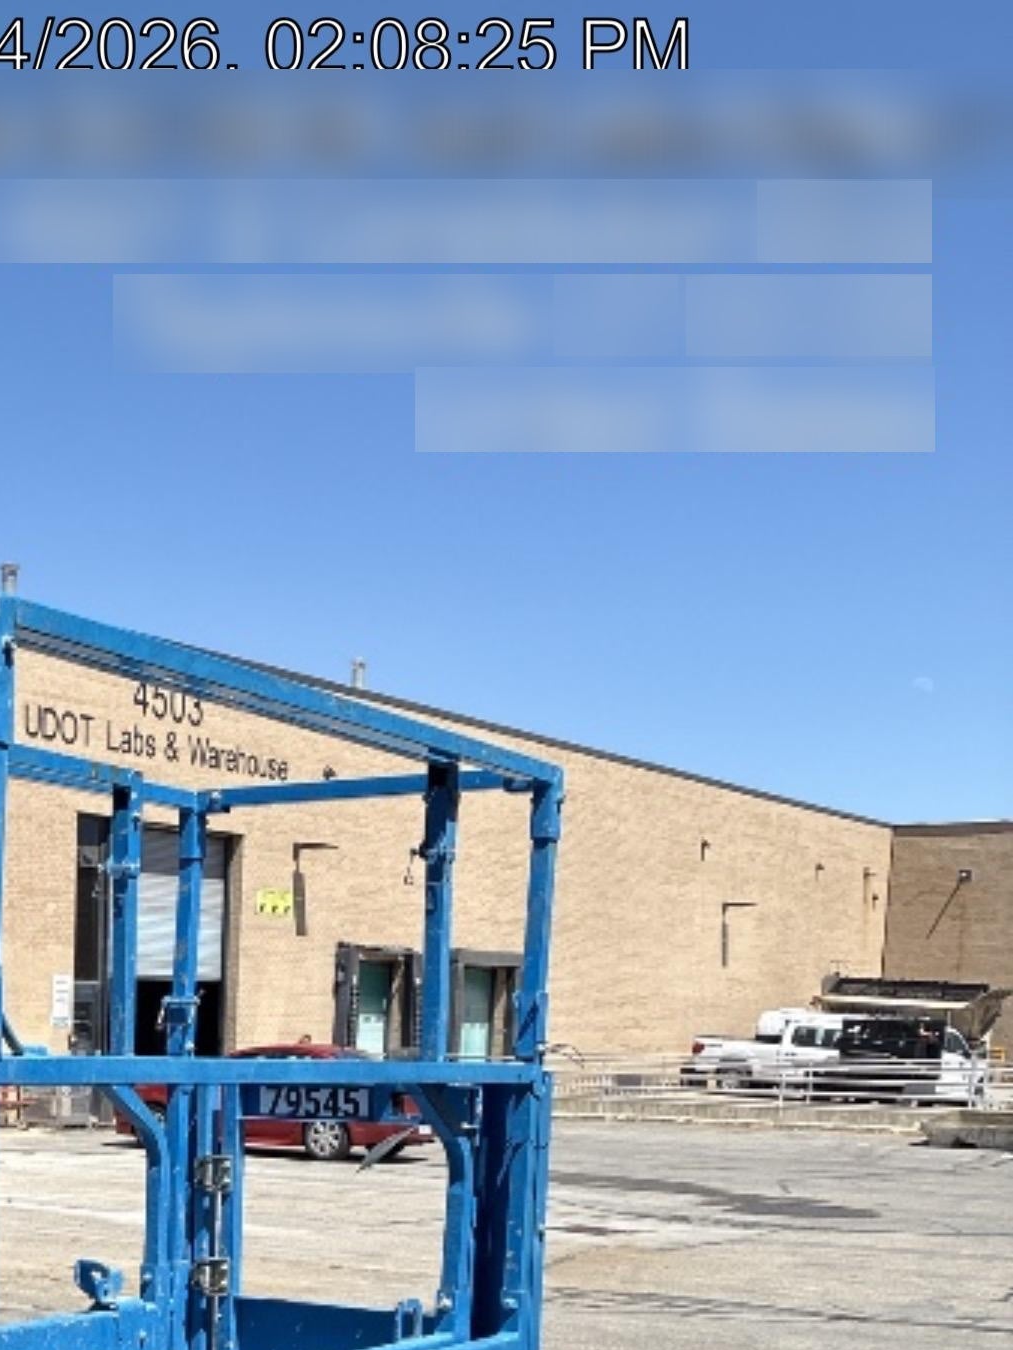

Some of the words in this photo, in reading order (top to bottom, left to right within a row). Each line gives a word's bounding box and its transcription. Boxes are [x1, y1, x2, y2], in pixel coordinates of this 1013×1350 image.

[133, 682, 204, 727] 4503
[25, 703, 95, 746] UDOT
[107, 719, 156, 759] Labs
[164, 731, 179, 762] &
[187, 734, 289, 781] Warehouse
